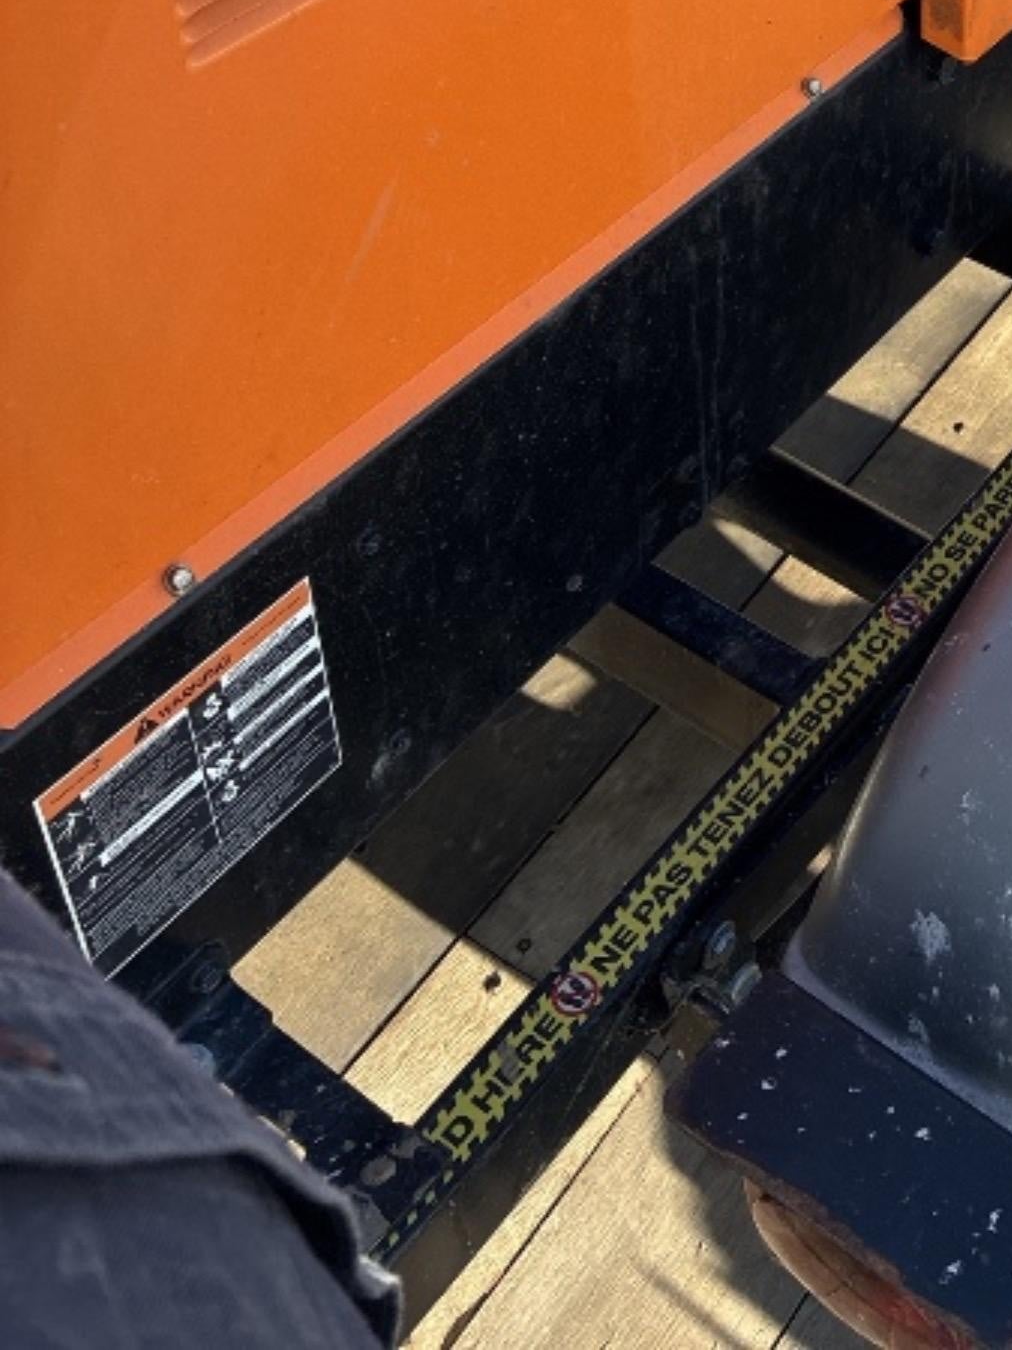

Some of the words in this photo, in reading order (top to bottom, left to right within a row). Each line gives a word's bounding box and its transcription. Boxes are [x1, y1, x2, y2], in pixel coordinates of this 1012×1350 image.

[914, 561, 950, 598] NO
[944, 529, 978, 563] SE
[590, 927, 638, 979] NE
[633, 864, 694, 930] PAS
[686, 772, 774, 860] TENEZ
[767, 662, 864, 771] DEBOUT
[860, 627, 896, 666] ICI
